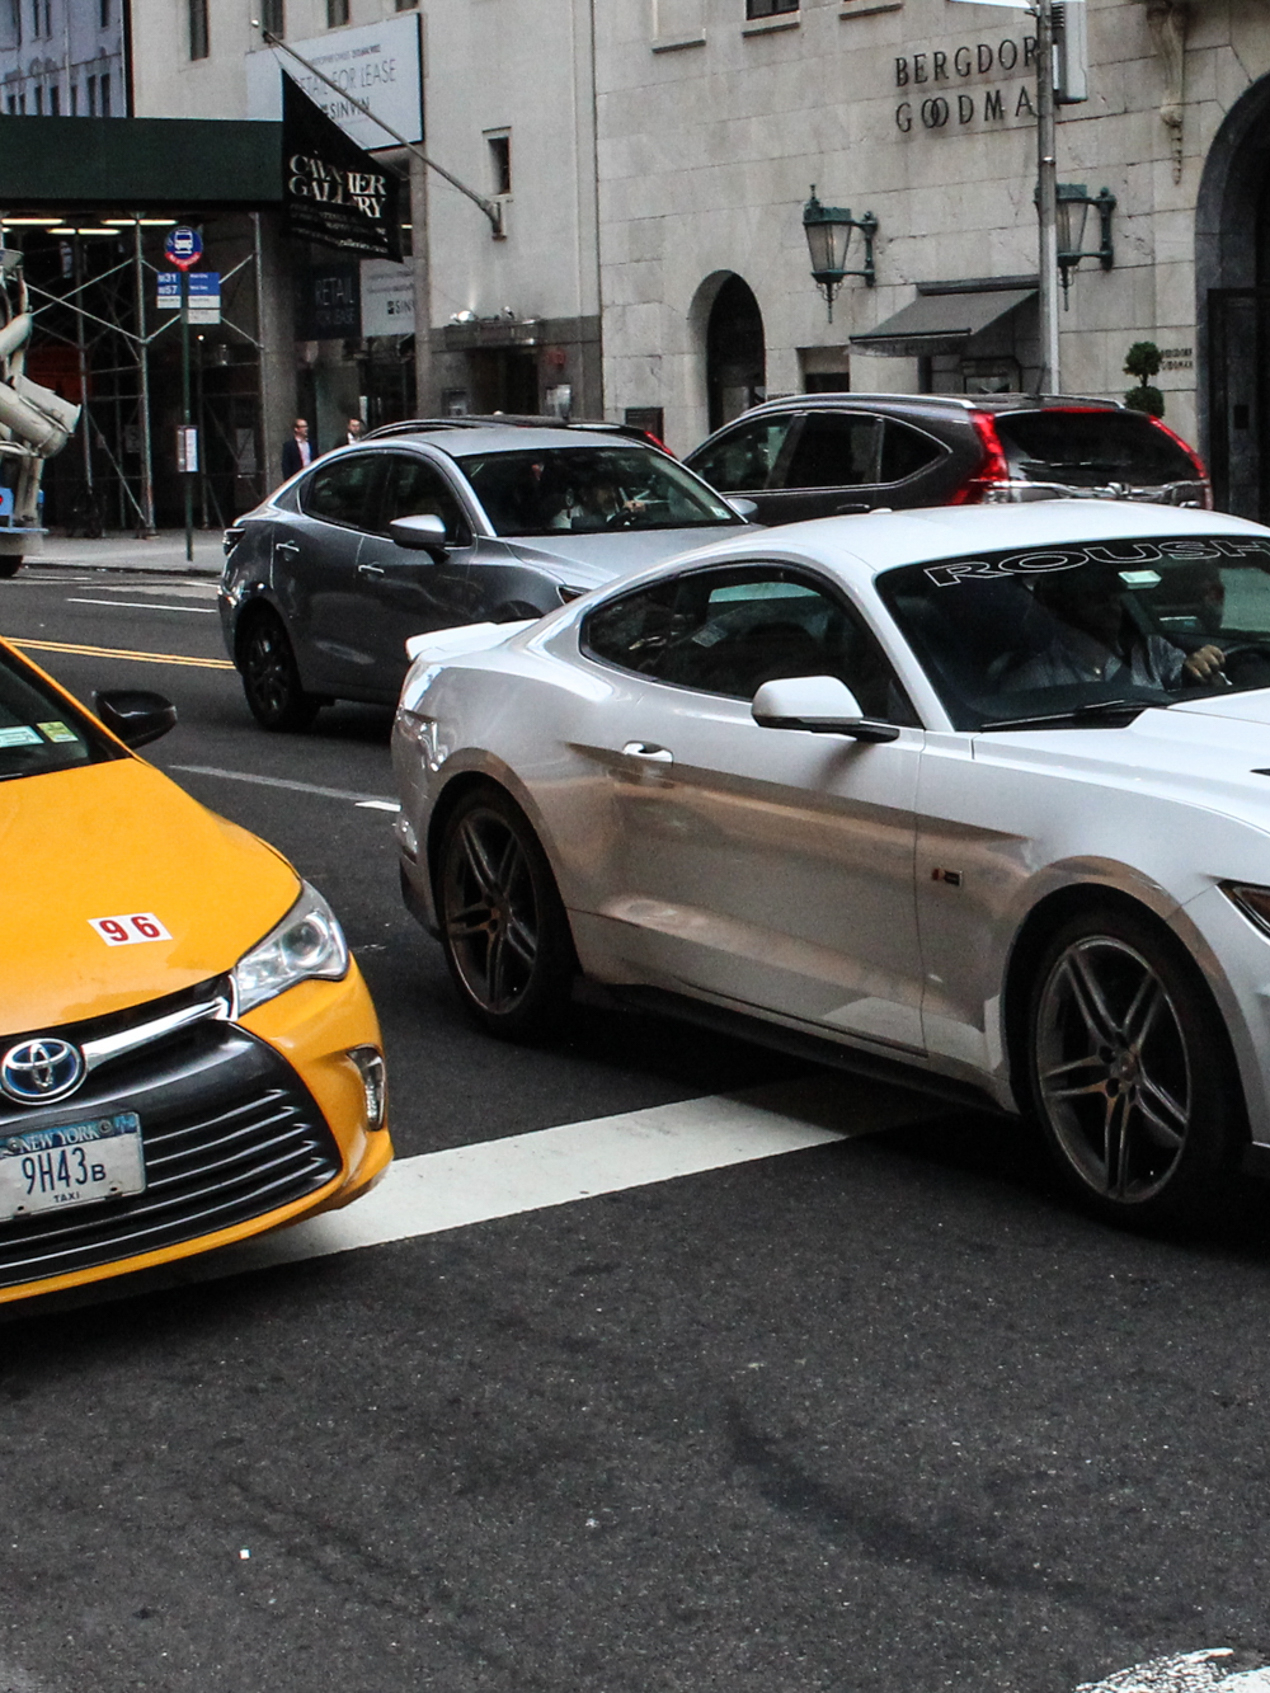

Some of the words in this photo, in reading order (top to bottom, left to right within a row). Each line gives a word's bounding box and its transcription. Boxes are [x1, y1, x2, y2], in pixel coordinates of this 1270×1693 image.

[361, 58, 397, 87] LEASE
[895, 36, 1038, 87] BERGDOR
[896, 86, 1039, 133] GOODMA
[289, 154, 387, 196] CAVAIER
[288, 175, 382, 218] GALLRY
[98, 915, 161, 942] 96
[19, 1131, 54, 1153] NEW
[59, 1124, 101, 1145] YORK
[53, 1191, 80, 1203] TAXI
